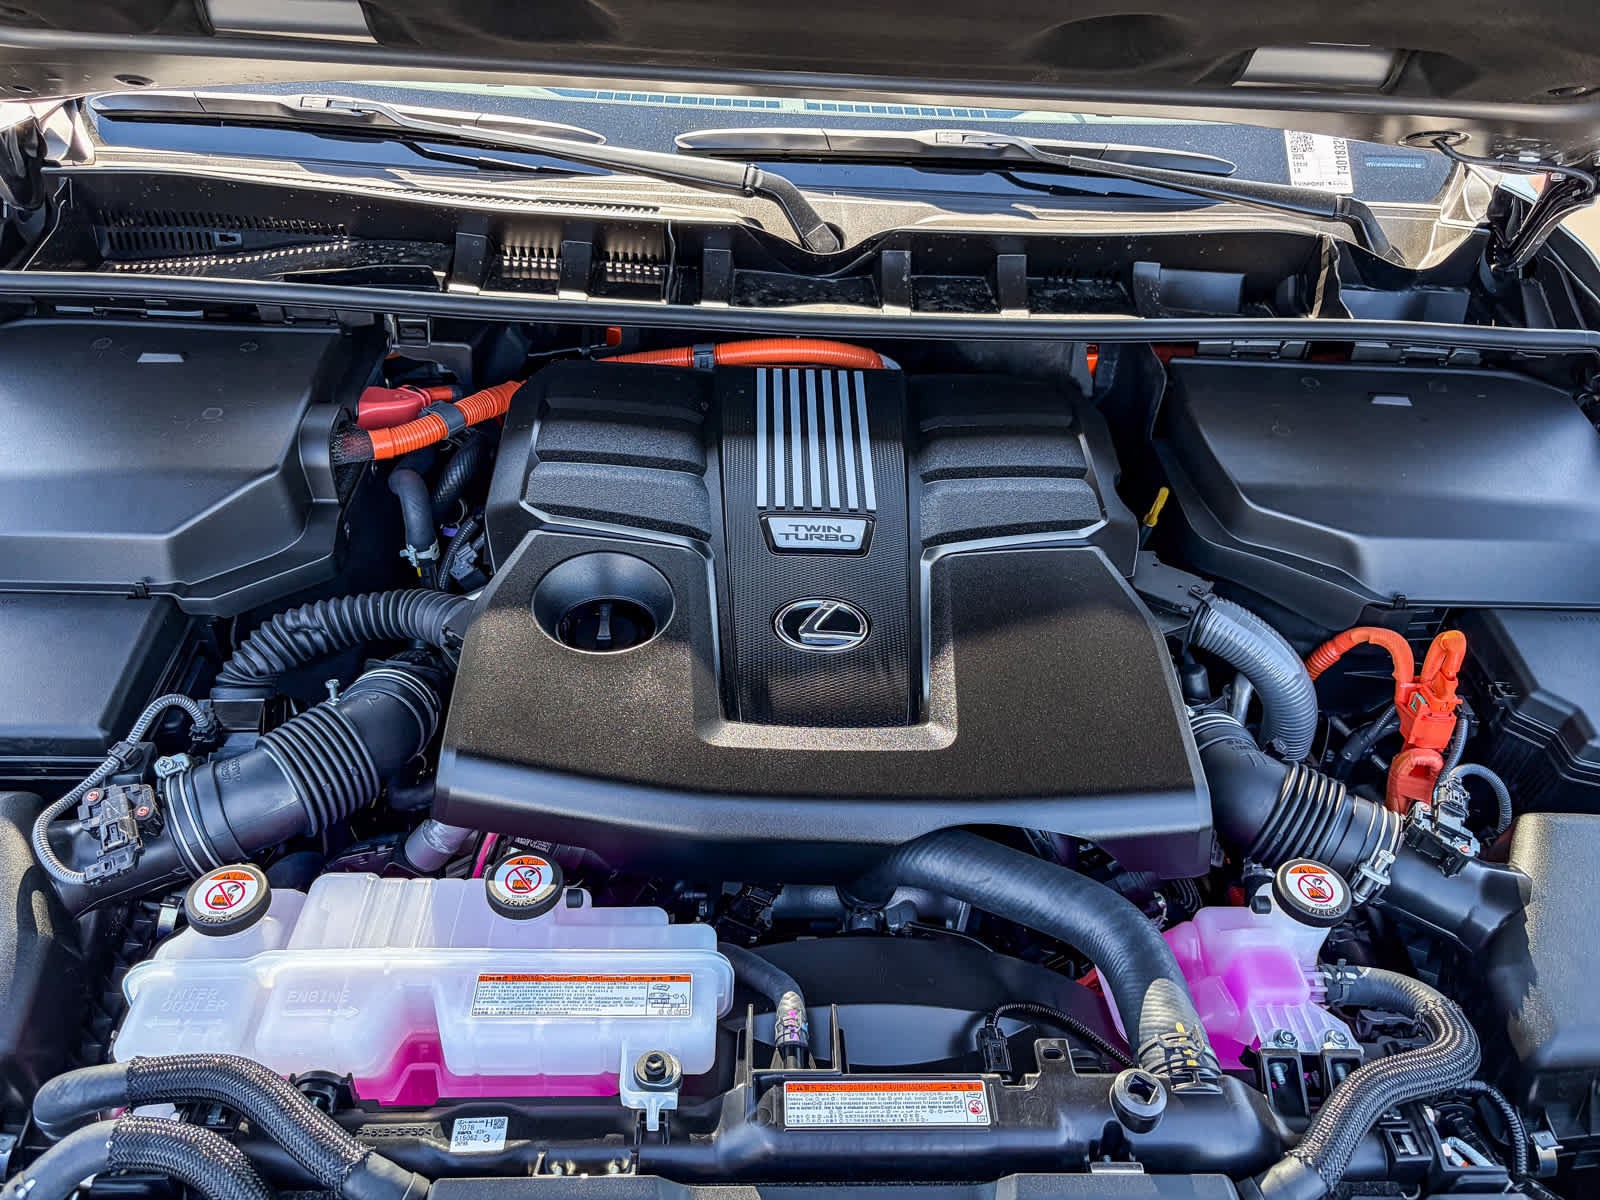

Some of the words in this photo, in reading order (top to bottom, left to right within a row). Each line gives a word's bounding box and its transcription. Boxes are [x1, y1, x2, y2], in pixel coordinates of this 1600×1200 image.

[788, 524, 842, 533] TWIN
[778, 533, 856, 542] TURBO
[287, 990, 351, 1003] ENGINE
